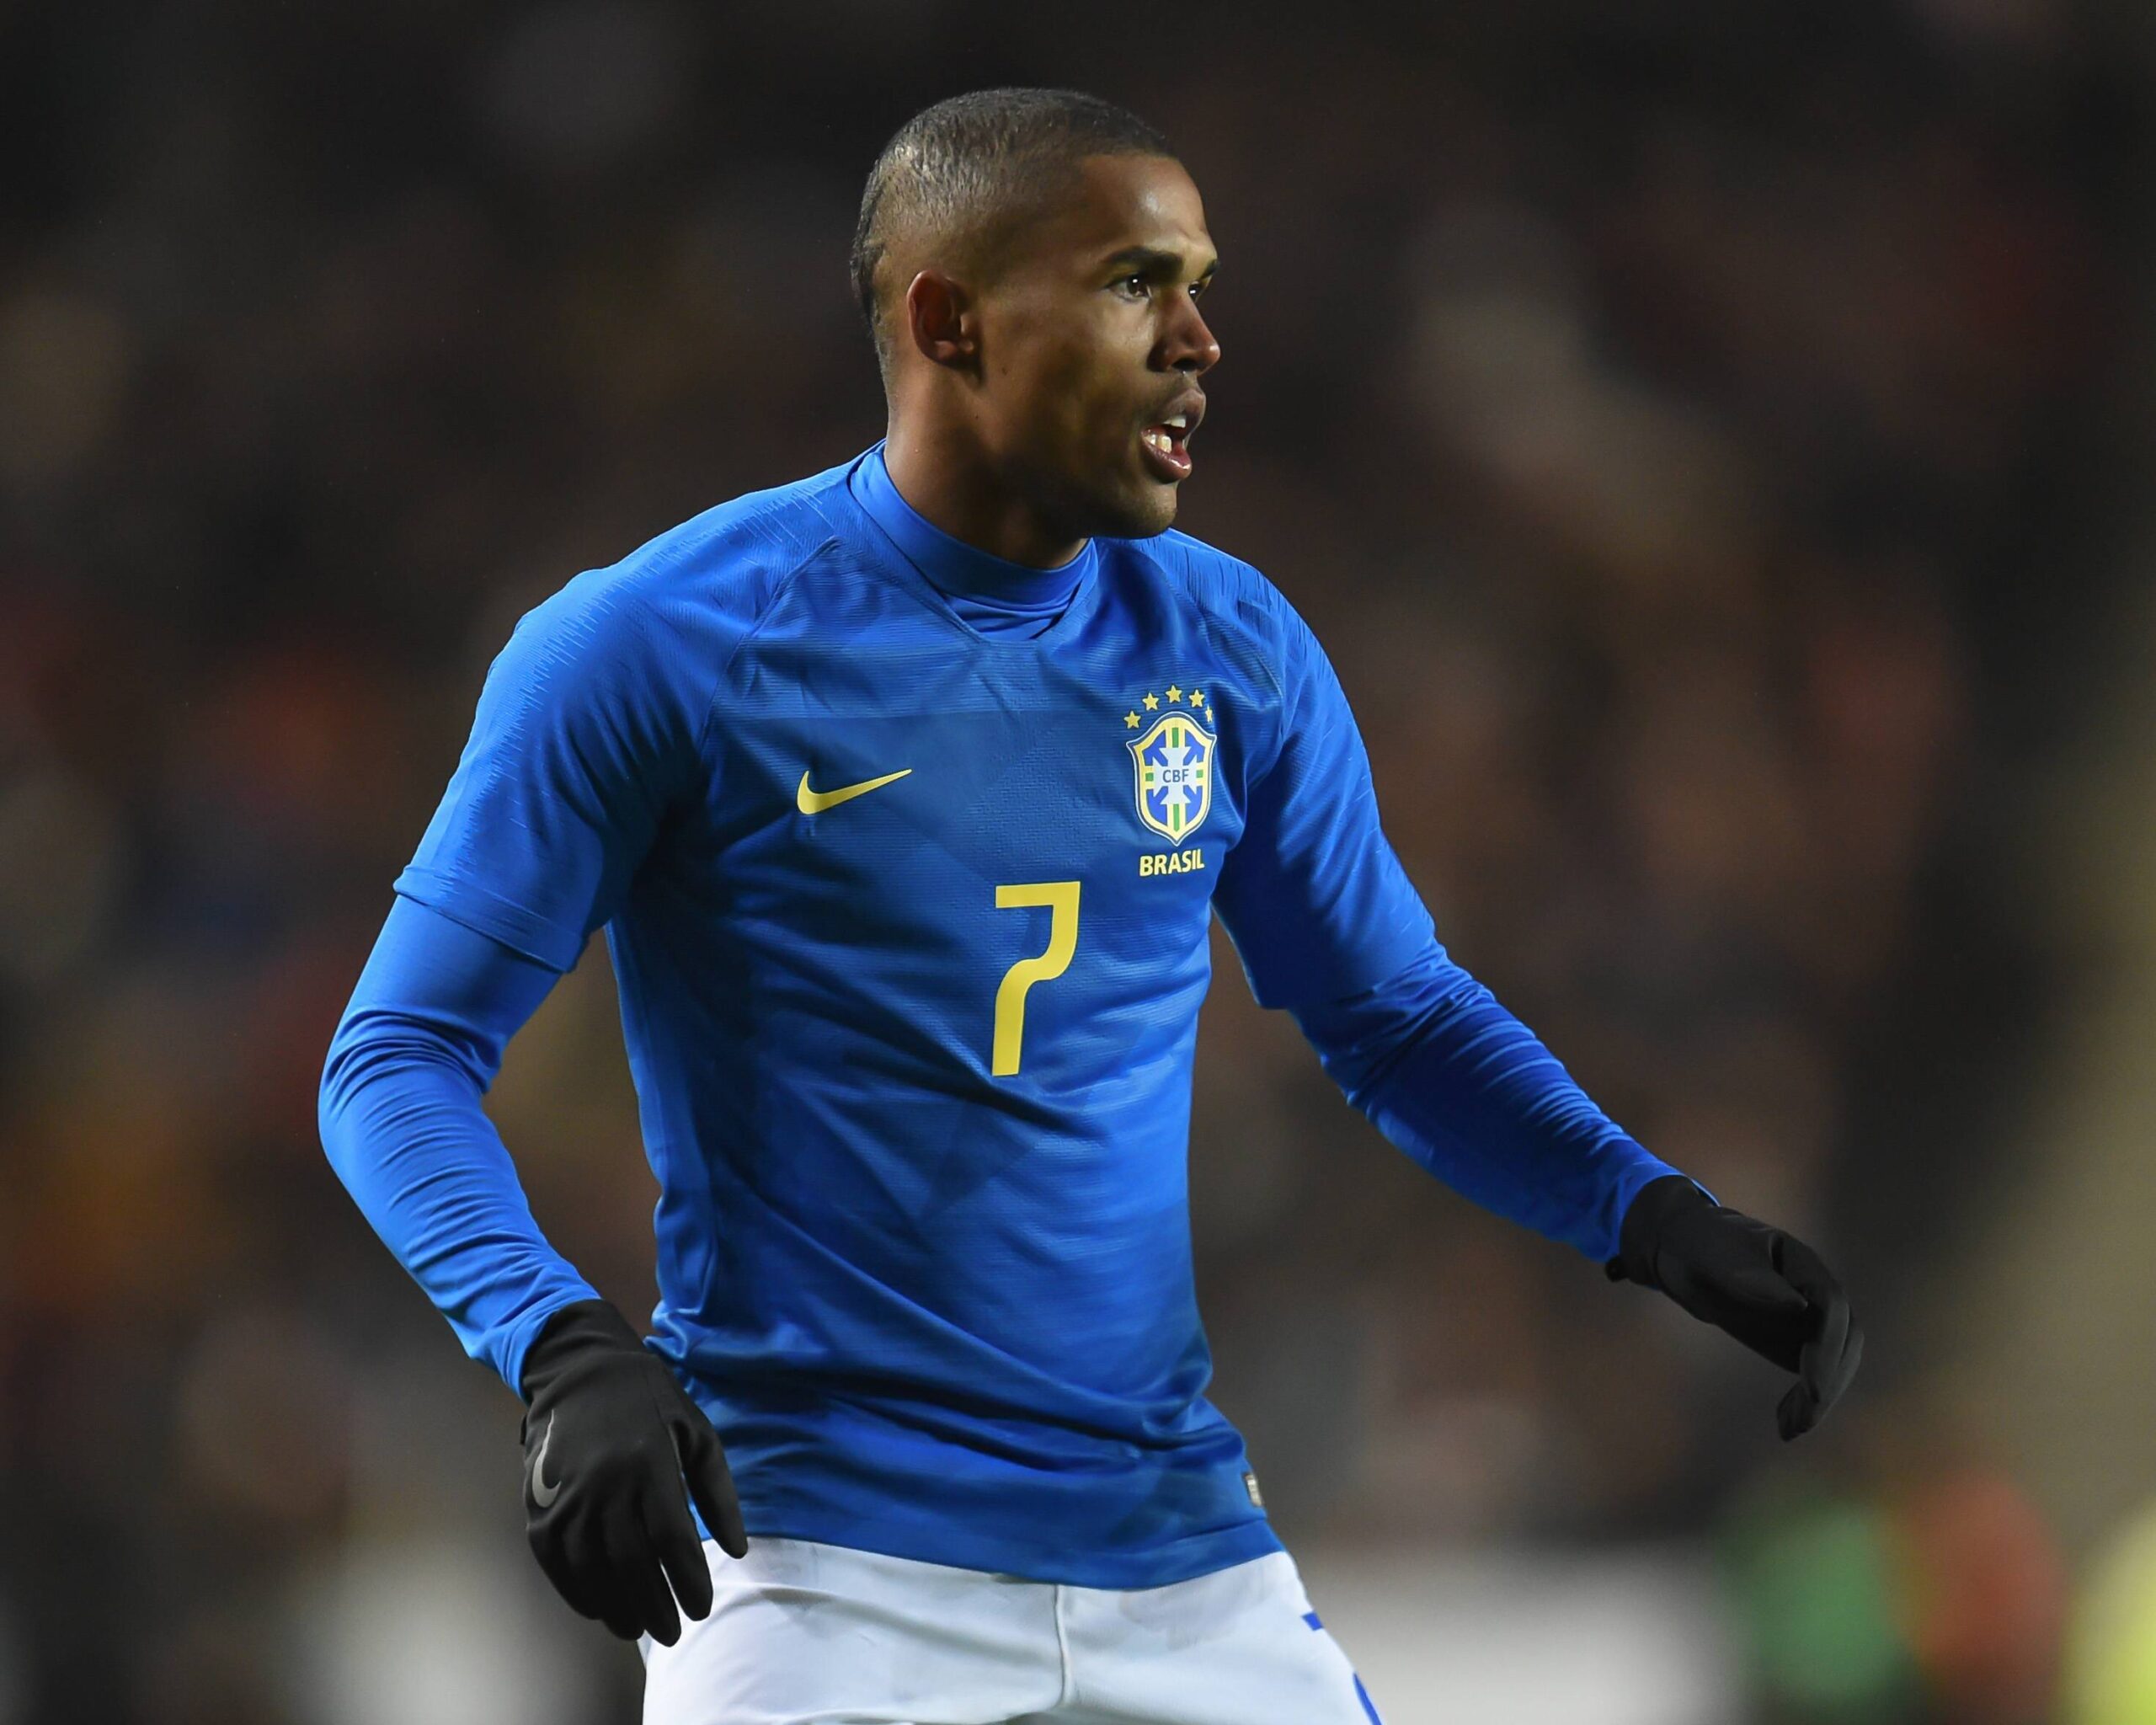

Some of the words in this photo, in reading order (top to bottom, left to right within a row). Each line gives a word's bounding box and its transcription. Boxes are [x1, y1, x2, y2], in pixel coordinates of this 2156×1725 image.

[1162, 769, 1189, 782] CBF
[1139, 848, 1204, 877] BRASIL
[992, 881, 1081, 1076] 7
